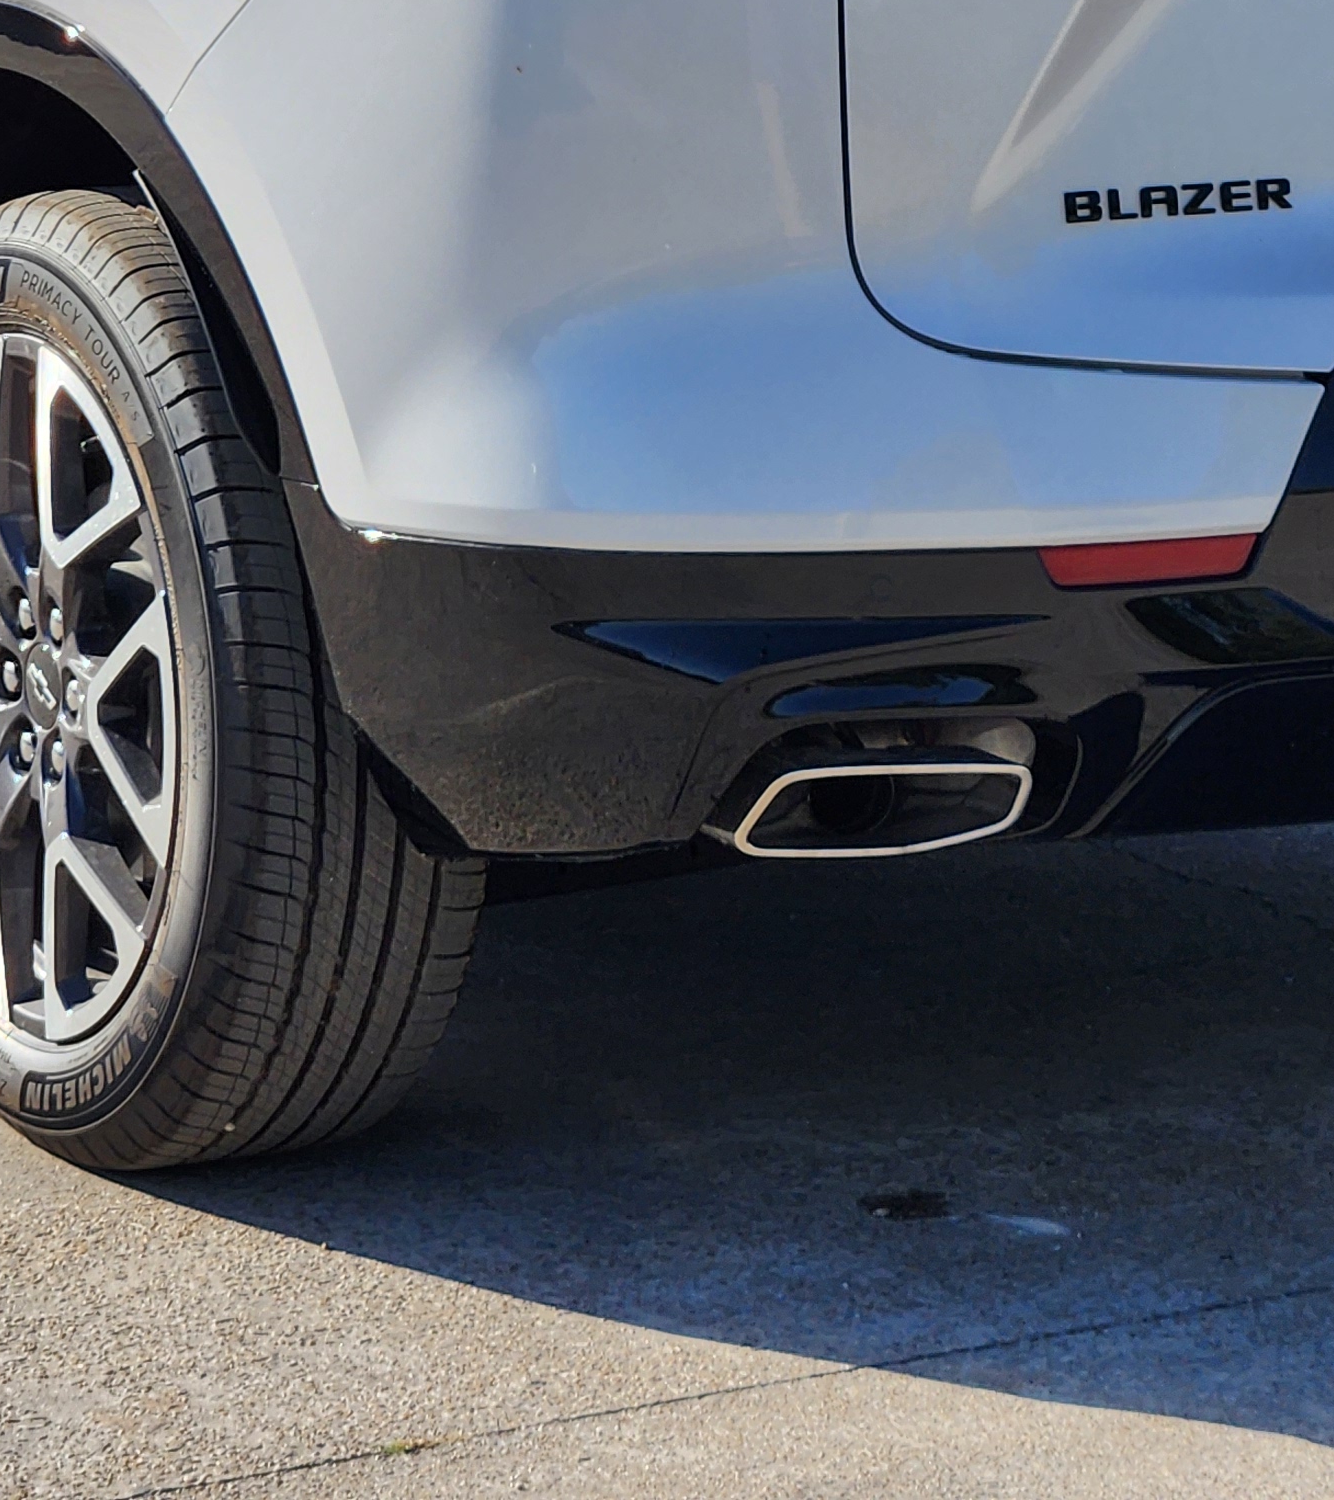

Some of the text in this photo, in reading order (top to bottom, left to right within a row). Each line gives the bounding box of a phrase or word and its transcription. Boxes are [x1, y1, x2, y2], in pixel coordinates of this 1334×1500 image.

[1063, 177, 1293, 224] BLAZER
[19, 269, 83, 324] PRIMACY
[83, 324, 121, 385] TOUR
[24, 1031, 132, 1111] MICHELIN
